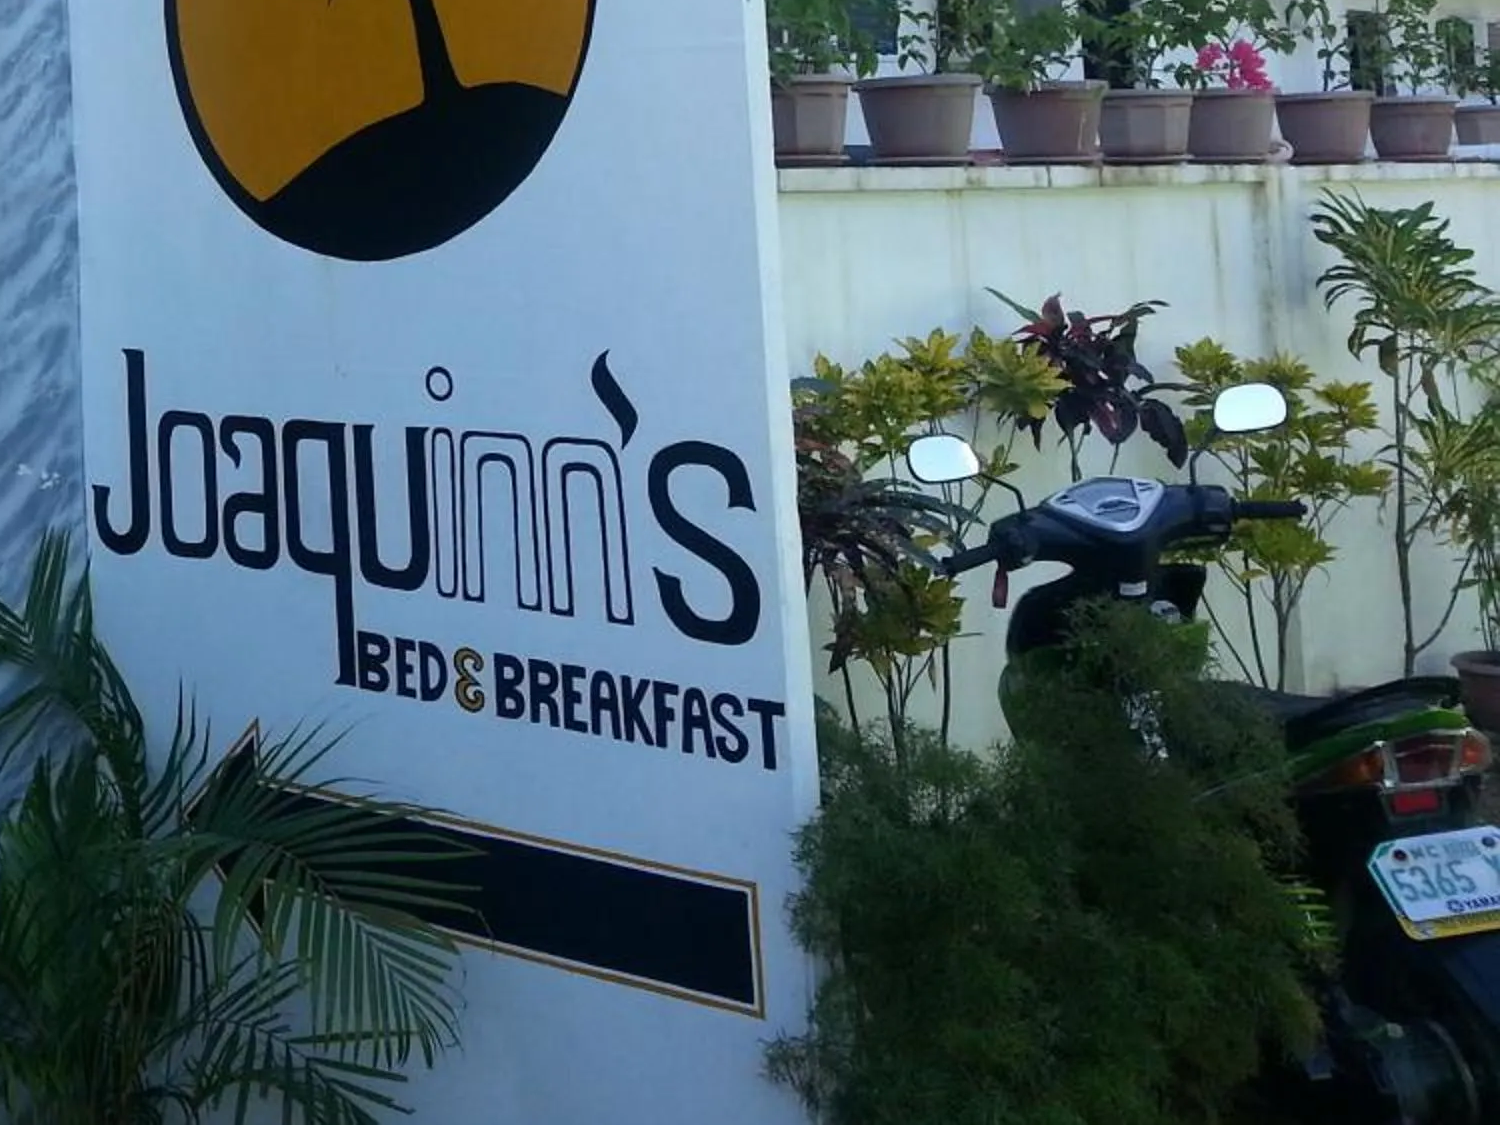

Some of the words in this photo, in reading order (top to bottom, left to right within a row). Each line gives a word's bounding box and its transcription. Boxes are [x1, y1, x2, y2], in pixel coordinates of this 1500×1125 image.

[92, 348, 761, 686] Joaquinn's
[355, 630, 448, 703] BED
[453, 646, 486, 713] &
[493, 652, 786, 772] BREAKFAST
